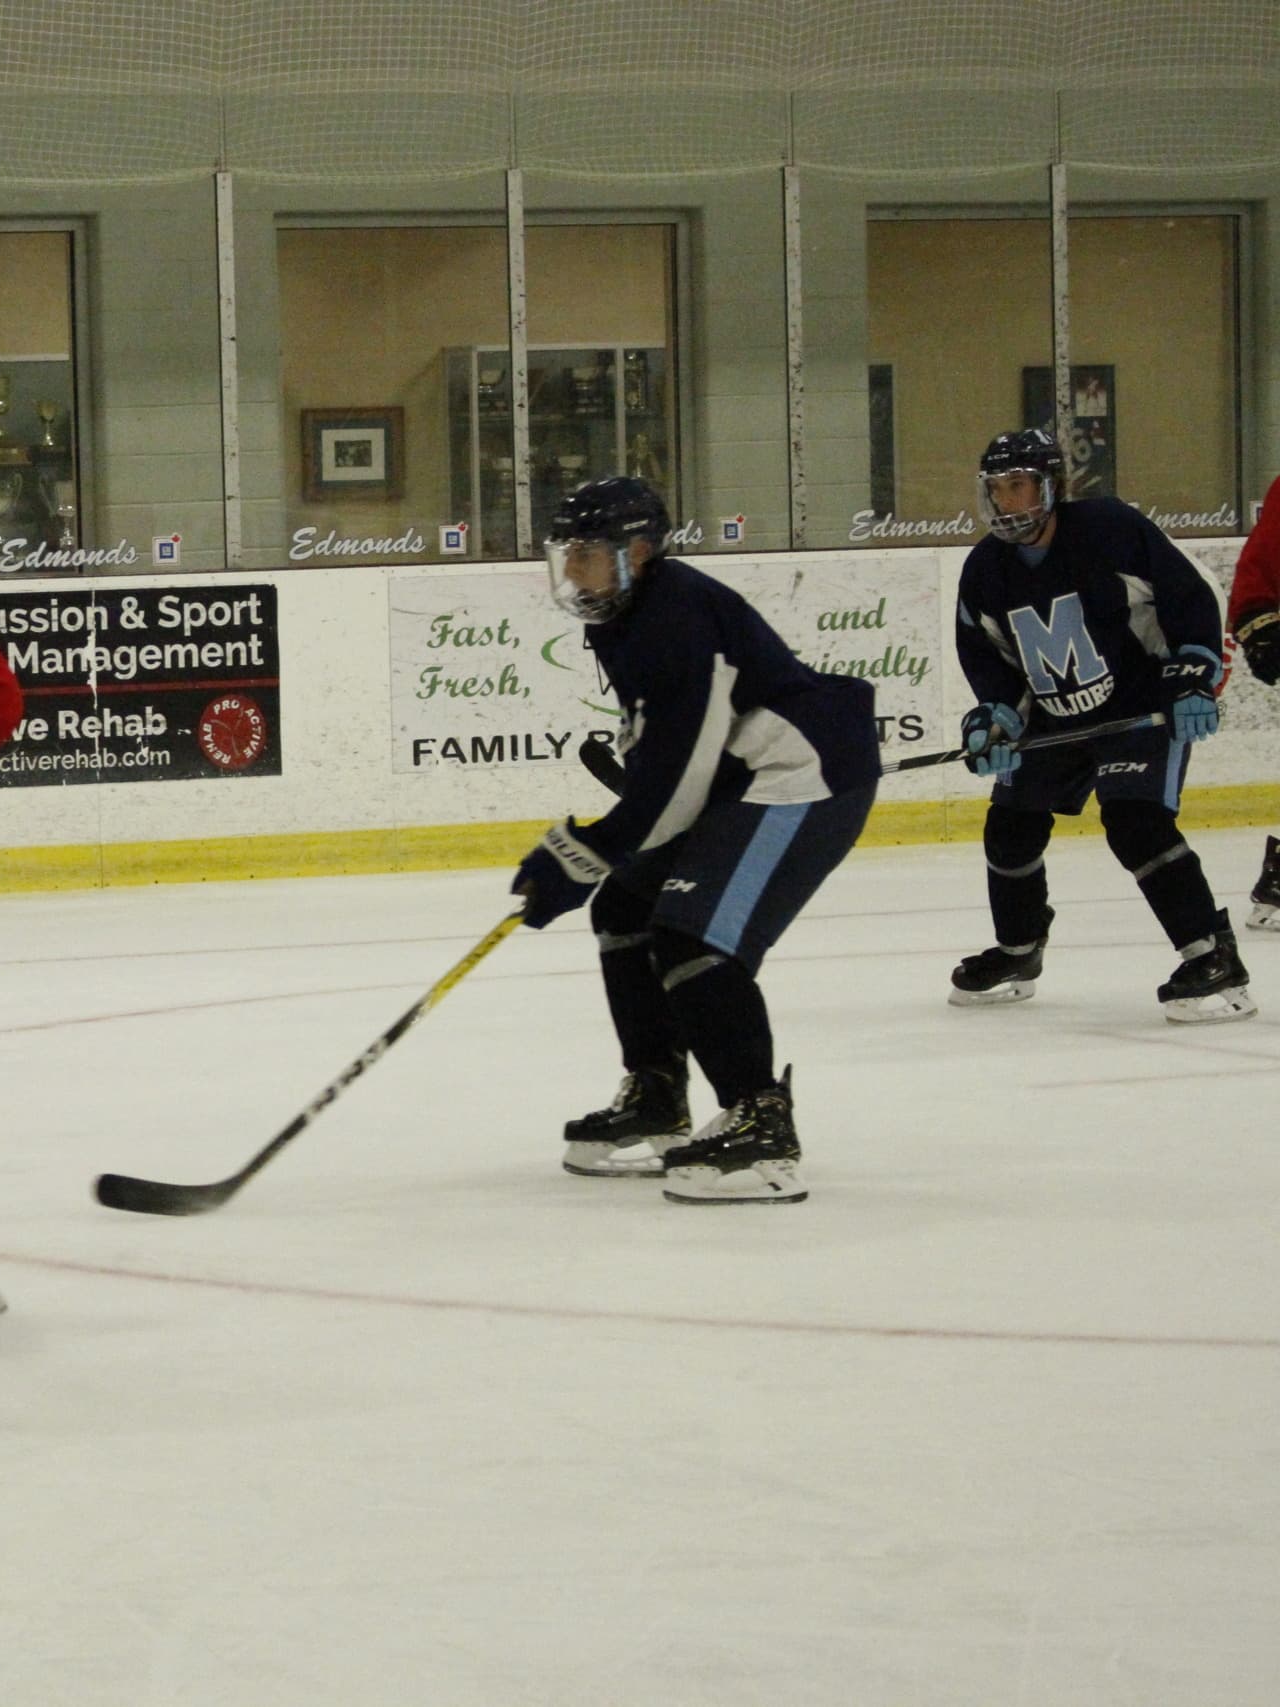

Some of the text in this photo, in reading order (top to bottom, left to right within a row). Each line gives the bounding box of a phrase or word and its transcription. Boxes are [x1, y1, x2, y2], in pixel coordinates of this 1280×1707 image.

[848, 509, 977, 541] Edmonds
[0, 538, 139, 573] Edmonds
[289, 526, 426, 561] Edmonds
[120, 596, 148, 630] &
[157, 593, 264, 637] Sport
[426, 614, 521, 649] Fast,
[817, 597, 888, 632] and
[6, 633, 264, 680] Management
[1007, 592, 1110, 695] M
[415, 664, 531, 700] Fresh,
[57, 705, 167, 741] Rehab
[202, 700, 261, 765] PRO ACTIVE REHAB
[413, 731, 572, 766] FAMILY
